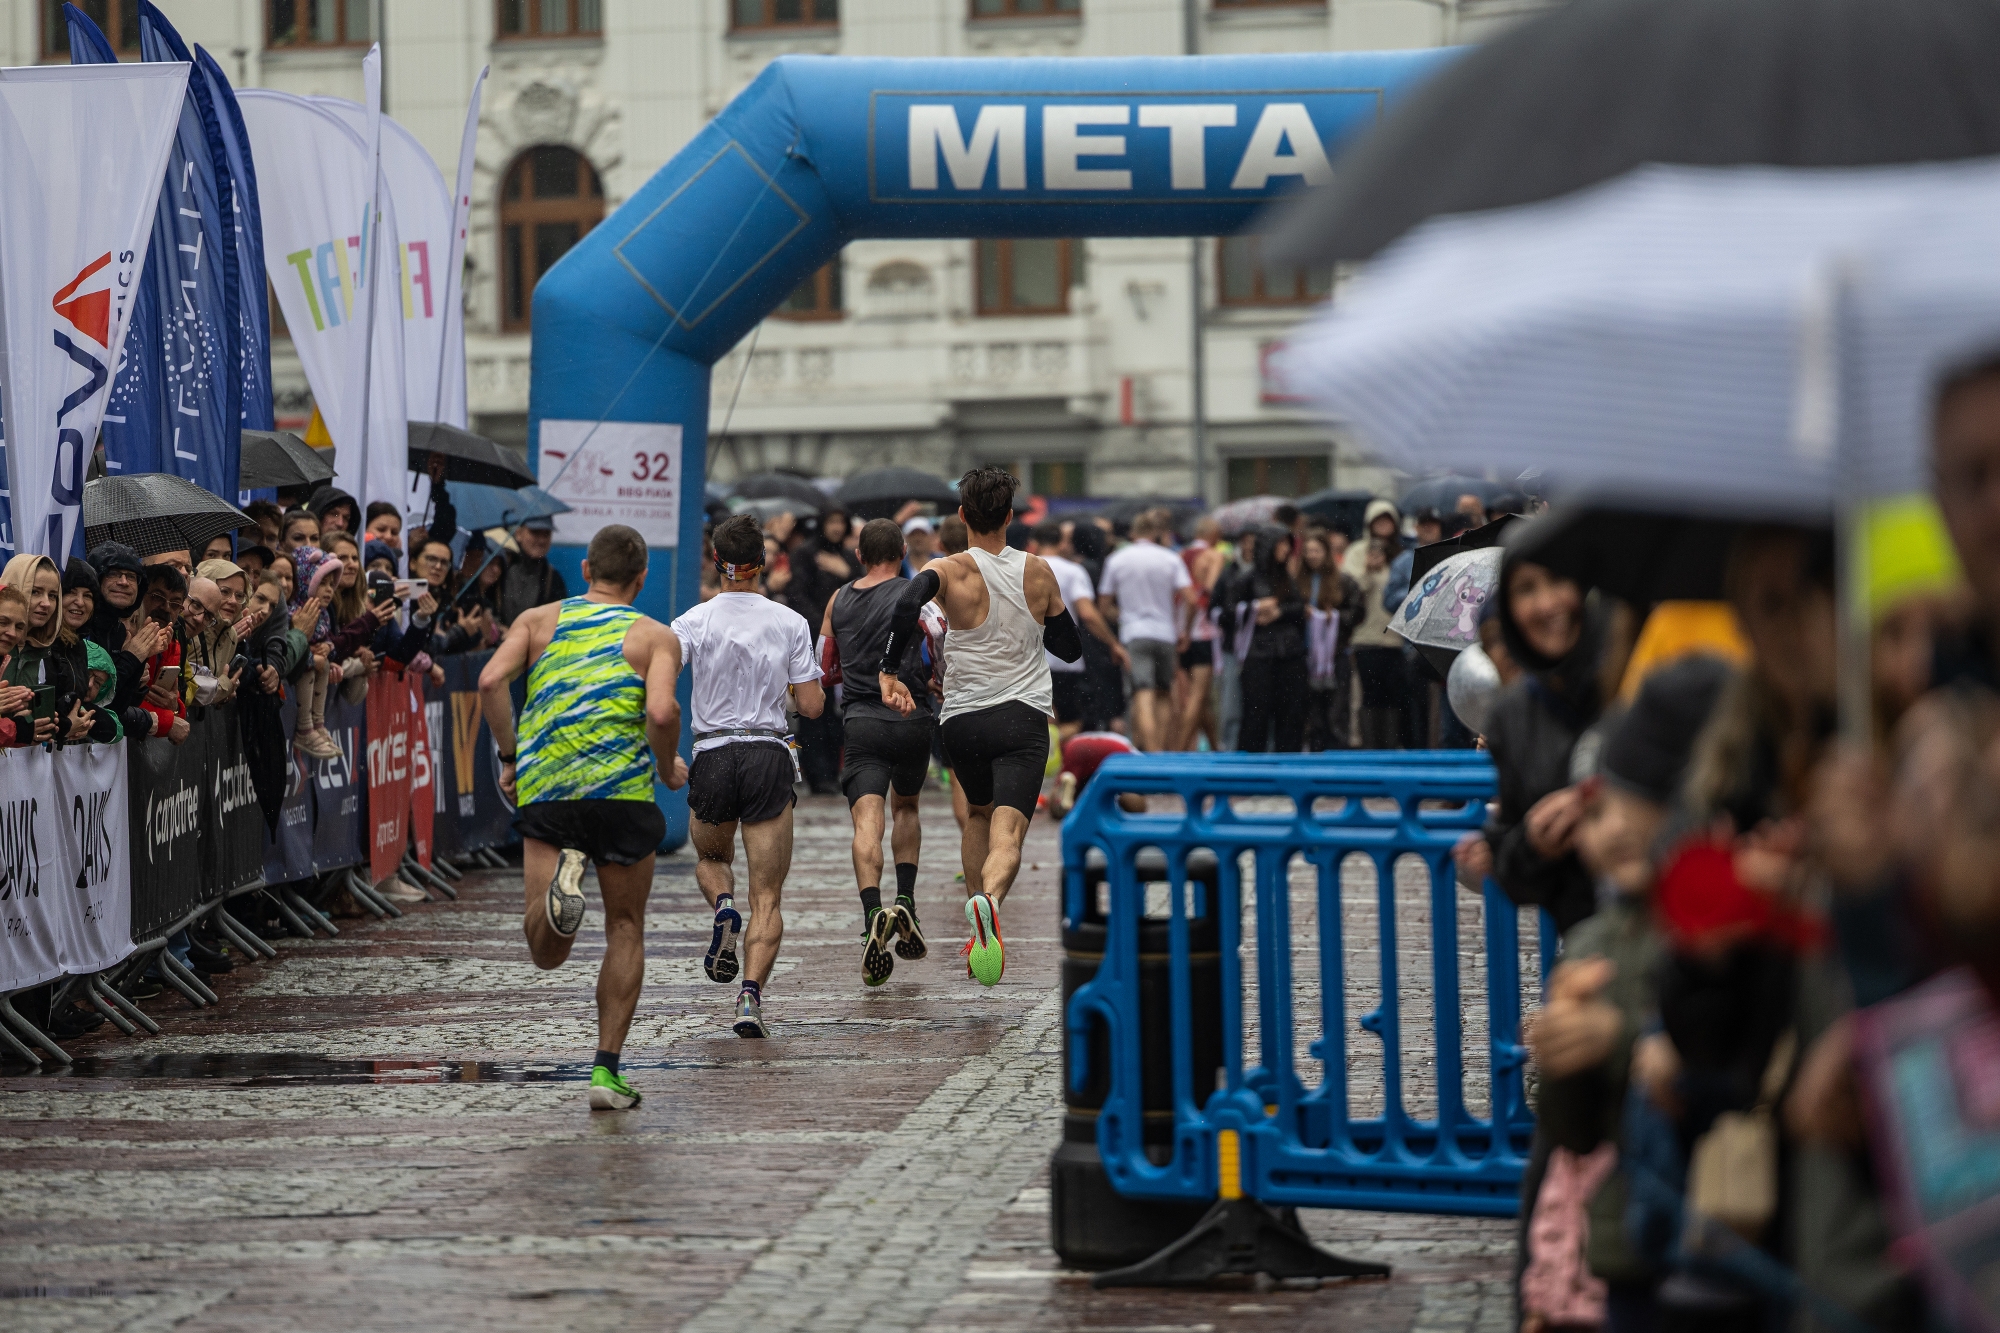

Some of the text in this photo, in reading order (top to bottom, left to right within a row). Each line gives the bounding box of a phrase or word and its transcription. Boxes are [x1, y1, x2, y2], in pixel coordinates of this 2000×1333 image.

[909, 104, 1334, 190] META
[632, 451, 670, 481] 32
[155, 778, 199, 861] carpatree
